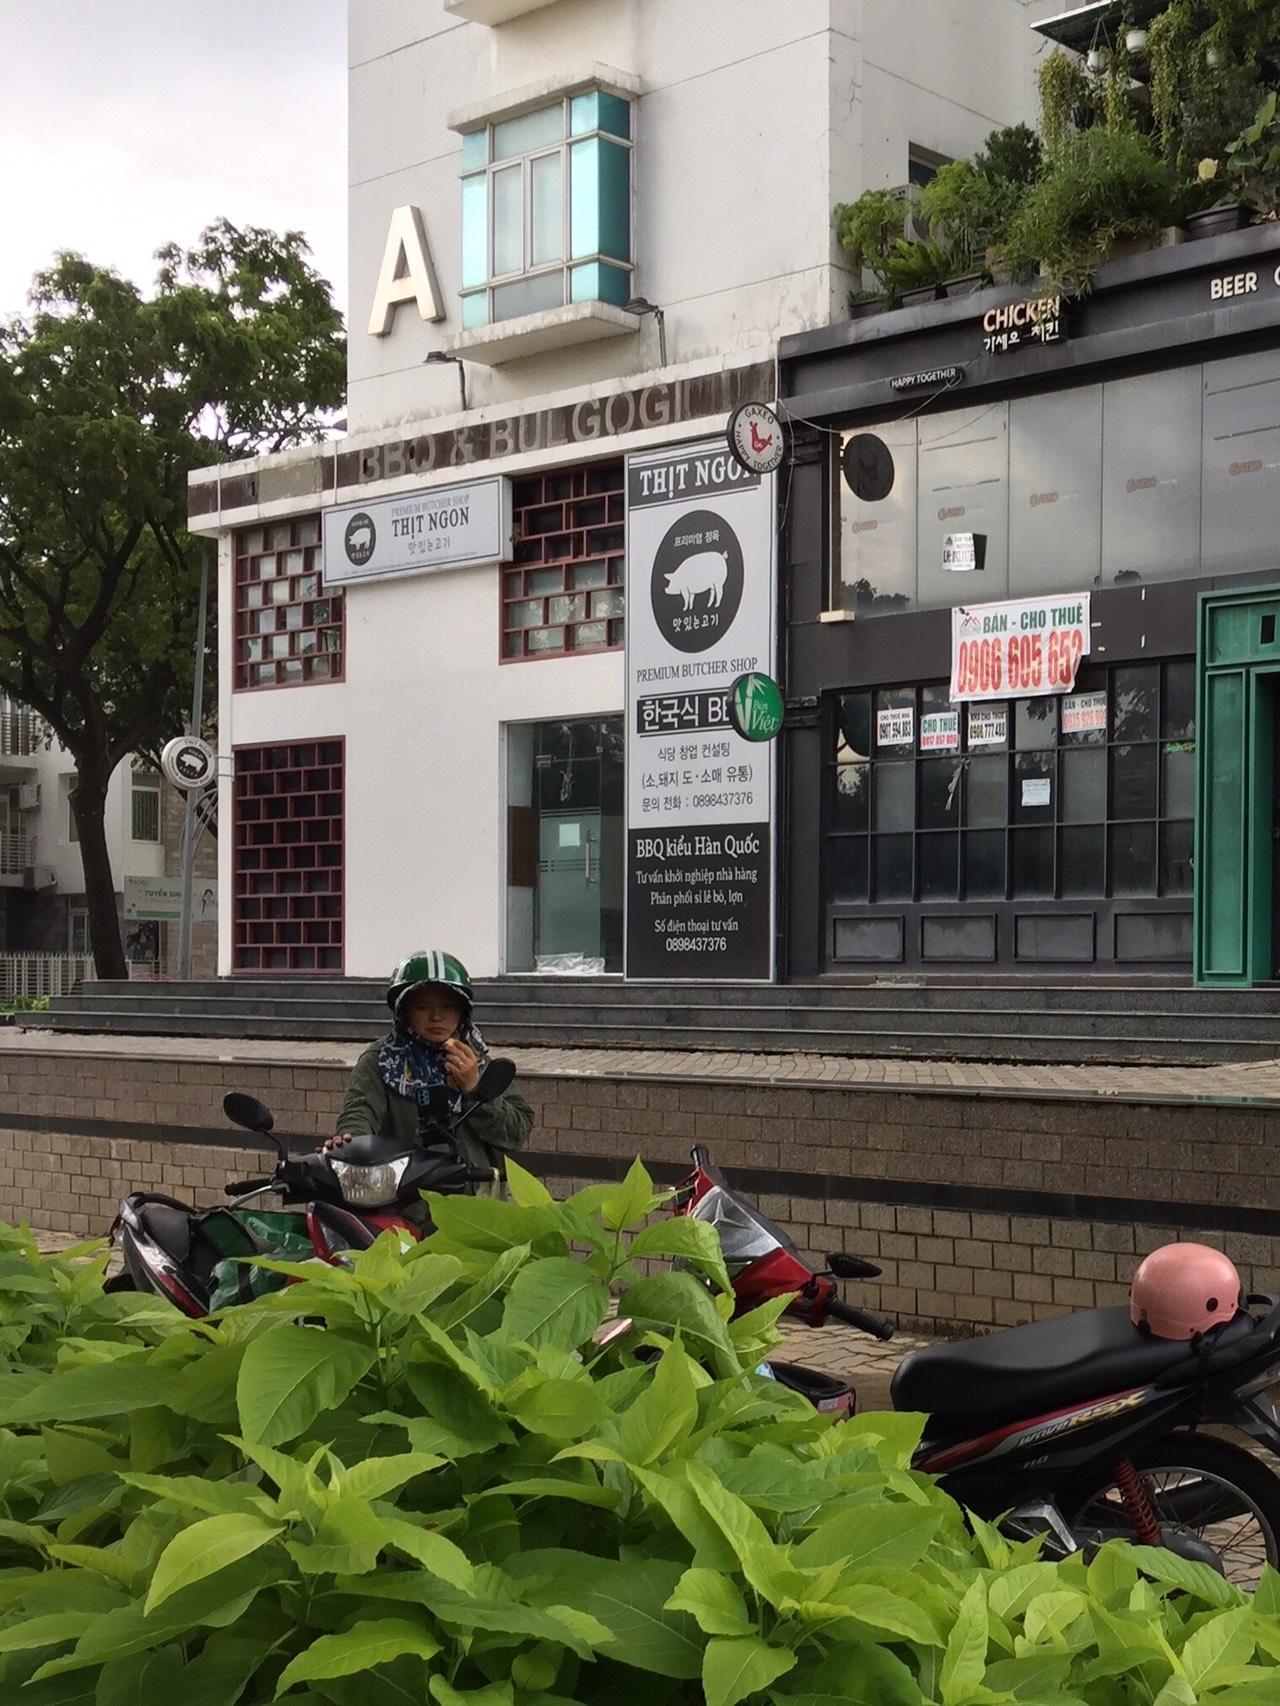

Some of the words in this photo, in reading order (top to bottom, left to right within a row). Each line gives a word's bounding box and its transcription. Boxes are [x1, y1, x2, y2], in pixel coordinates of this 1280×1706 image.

[367, 204, 447, 337] A
[1210, 271, 1258, 300] BEER
[983, 296, 1061, 333] CHICKEN
[1031, 320, 1060, 343] 치킨
[891, 375, 916, 389] HAPPY
[916, 367, 956, 385] TOGETHER
[744, 406, 774, 425] GAXEO
[359, 435, 436, 484] BBQ
[489, 380, 682, 460] BULGOGI
[735, 430, 752, 461] HAPPY
[753, 444, 783, 471] TOGETHER
[640, 465, 689, 499] THỊT
[695, 455, 758, 487] NGO
[391, 502, 422, 518] PREMIUM
[422, 497, 450, 513] BUTCHER
[452, 494, 470, 507] SHOP
[391, 514, 425, 539] THỊT
[428, 506, 470, 532] NGON
[674, 533, 703, 548] 프리미엄
[704, 529, 720, 544] 정육
[983, 612, 1008, 634] BÁN
[1020, 609, 1046, 631] CHO
[1050, 602, 1083, 626] THUÊ
[636, 664, 680, 683] PREMIUM
[682, 660, 728, 678] BUTCHER
[731, 656, 758, 673] SHOP
[957, 637, 1002, 694] 0906
[1007, 634, 1042, 689] 605
[642, 695, 699, 731] 한국식
[752, 710, 780, 734] Việt
[922, 719, 937, 733] CHO
[939, 715, 957, 732] THUÊ
[658, 746, 676, 762] 식당
[680, 744, 698, 761] 창업
[702, 742, 730, 758] 컨설팅
[727, 765, 753, 783] 유통)
[642, 798, 660, 812] 문의
[663, 795, 681, 810] 전화
[692, 791, 753, 808] 0898437376
[636, 838, 665, 861] BBQ
[665, 834, 692, 857] kiểu
[694, 836, 722, 856] Hàn
[724, 832, 760, 858] Quốc
[648, 869, 663, 883] vấn
[684, 868, 715, 885] nghiệp
[716, 867, 733, 881] nhà
[734, 866, 758, 883] hàng
[650, 891, 672, 905] Phân
[673, 889, 692, 907] phối
[712, 889, 726, 905] bò,
[728, 889, 743, 905] lợn
[654, 918, 667, 932] Số
[667, 919, 686, 934] điện
[687, 918, 710, 934] thoại
[711, 919, 722, 931] tư
[722, 917, 739, 931] vấn
[665, 937, 727, 951] 0898437376
[1068, 1390, 1149, 1427] RSX
